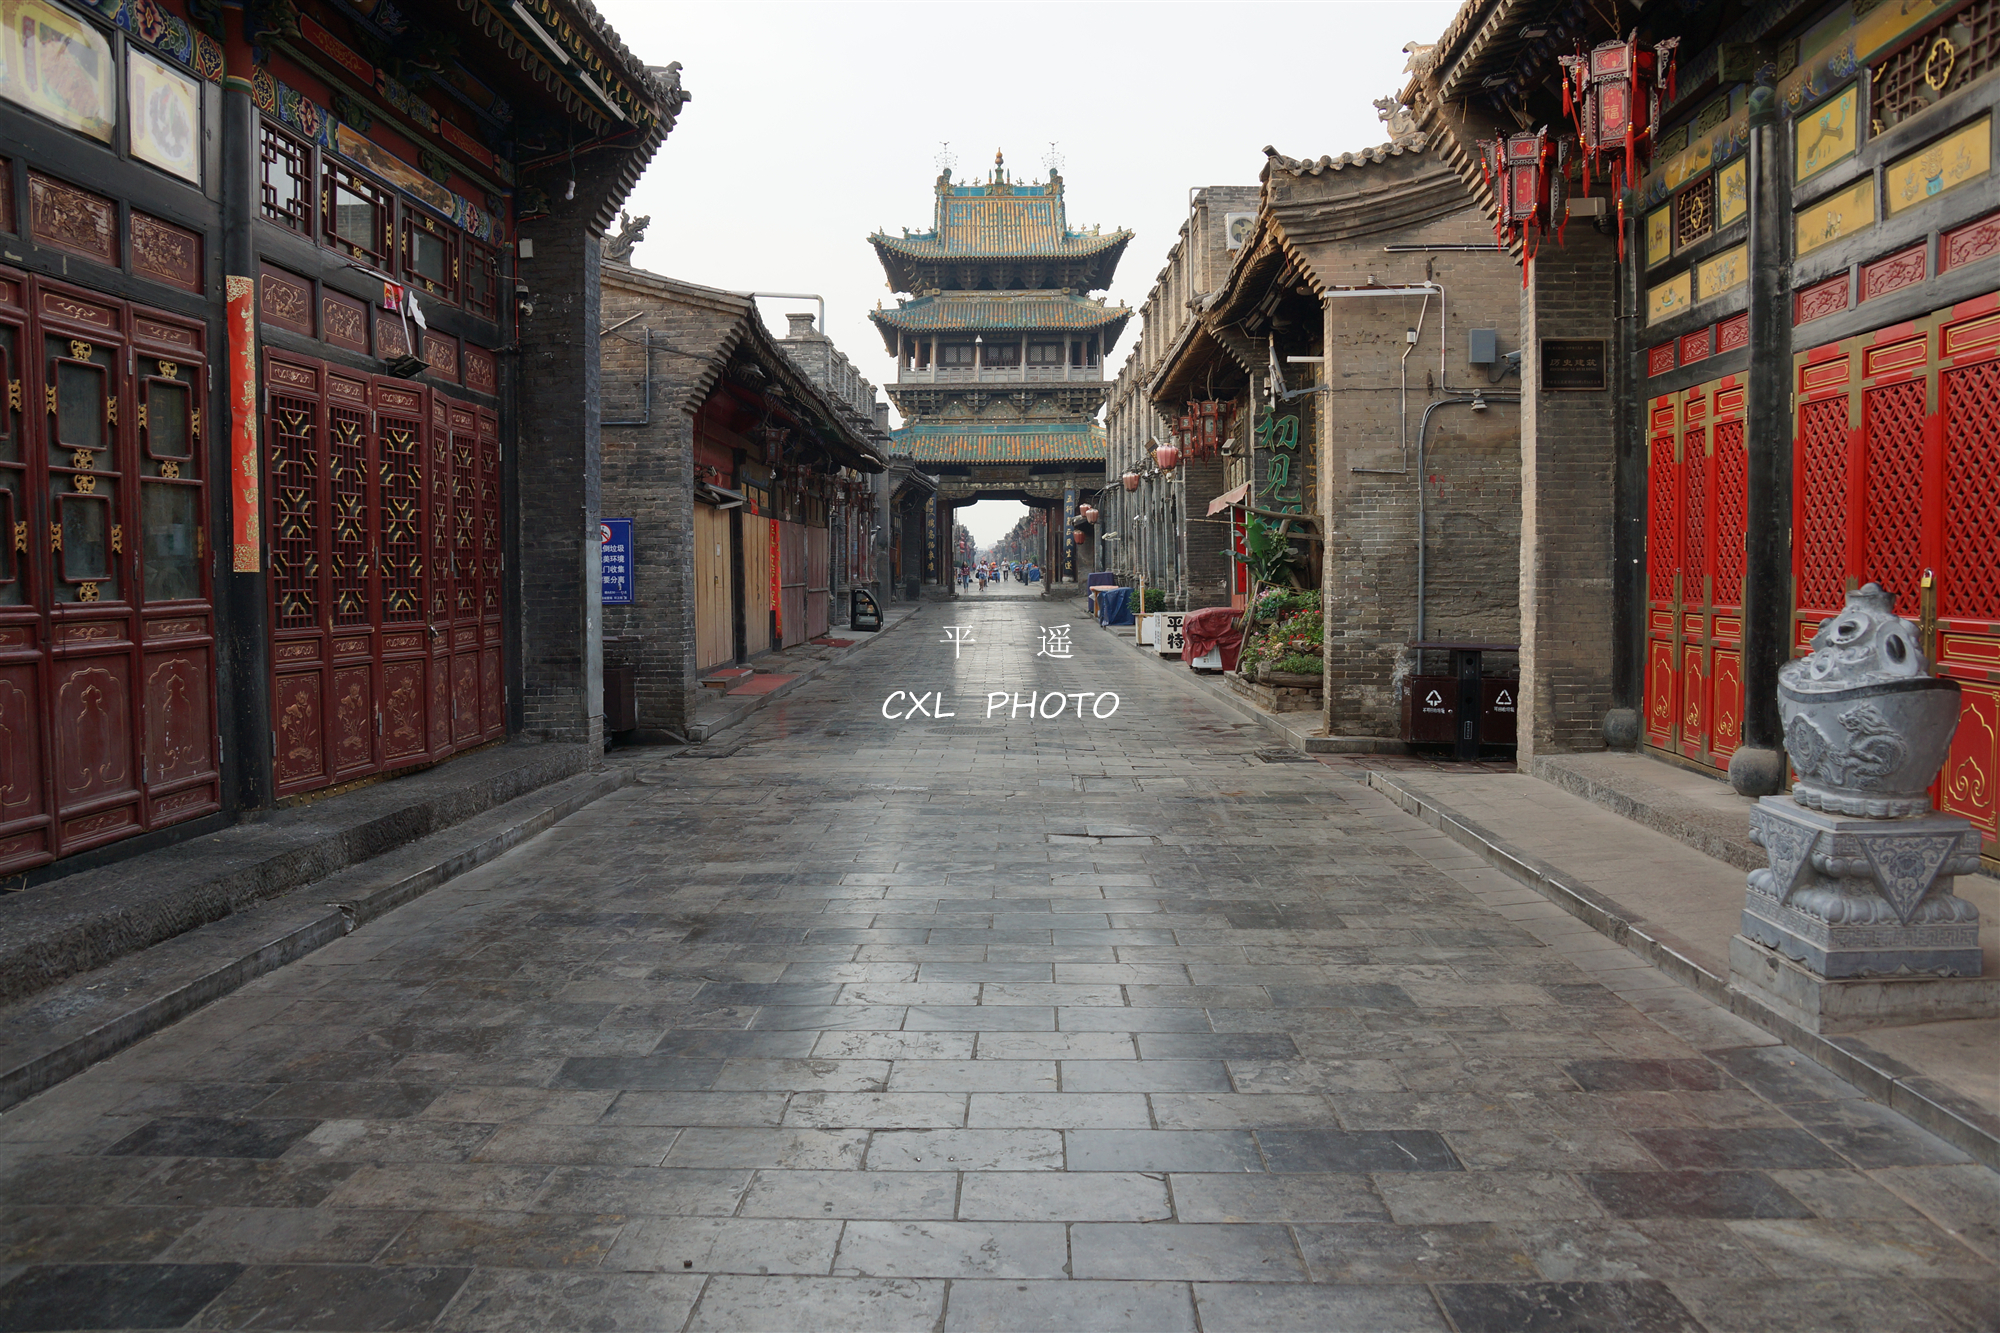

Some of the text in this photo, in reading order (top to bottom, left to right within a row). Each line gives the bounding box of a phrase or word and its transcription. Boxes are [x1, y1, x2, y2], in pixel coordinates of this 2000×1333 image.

[1604, 104, 1619, 120] 福
[602, 544, 625, 553] 倒垃圾
[602, 555, 625, 563] 美环境
[602, 565, 625, 574] 门收集
[602, 575, 625, 584] 要分离
